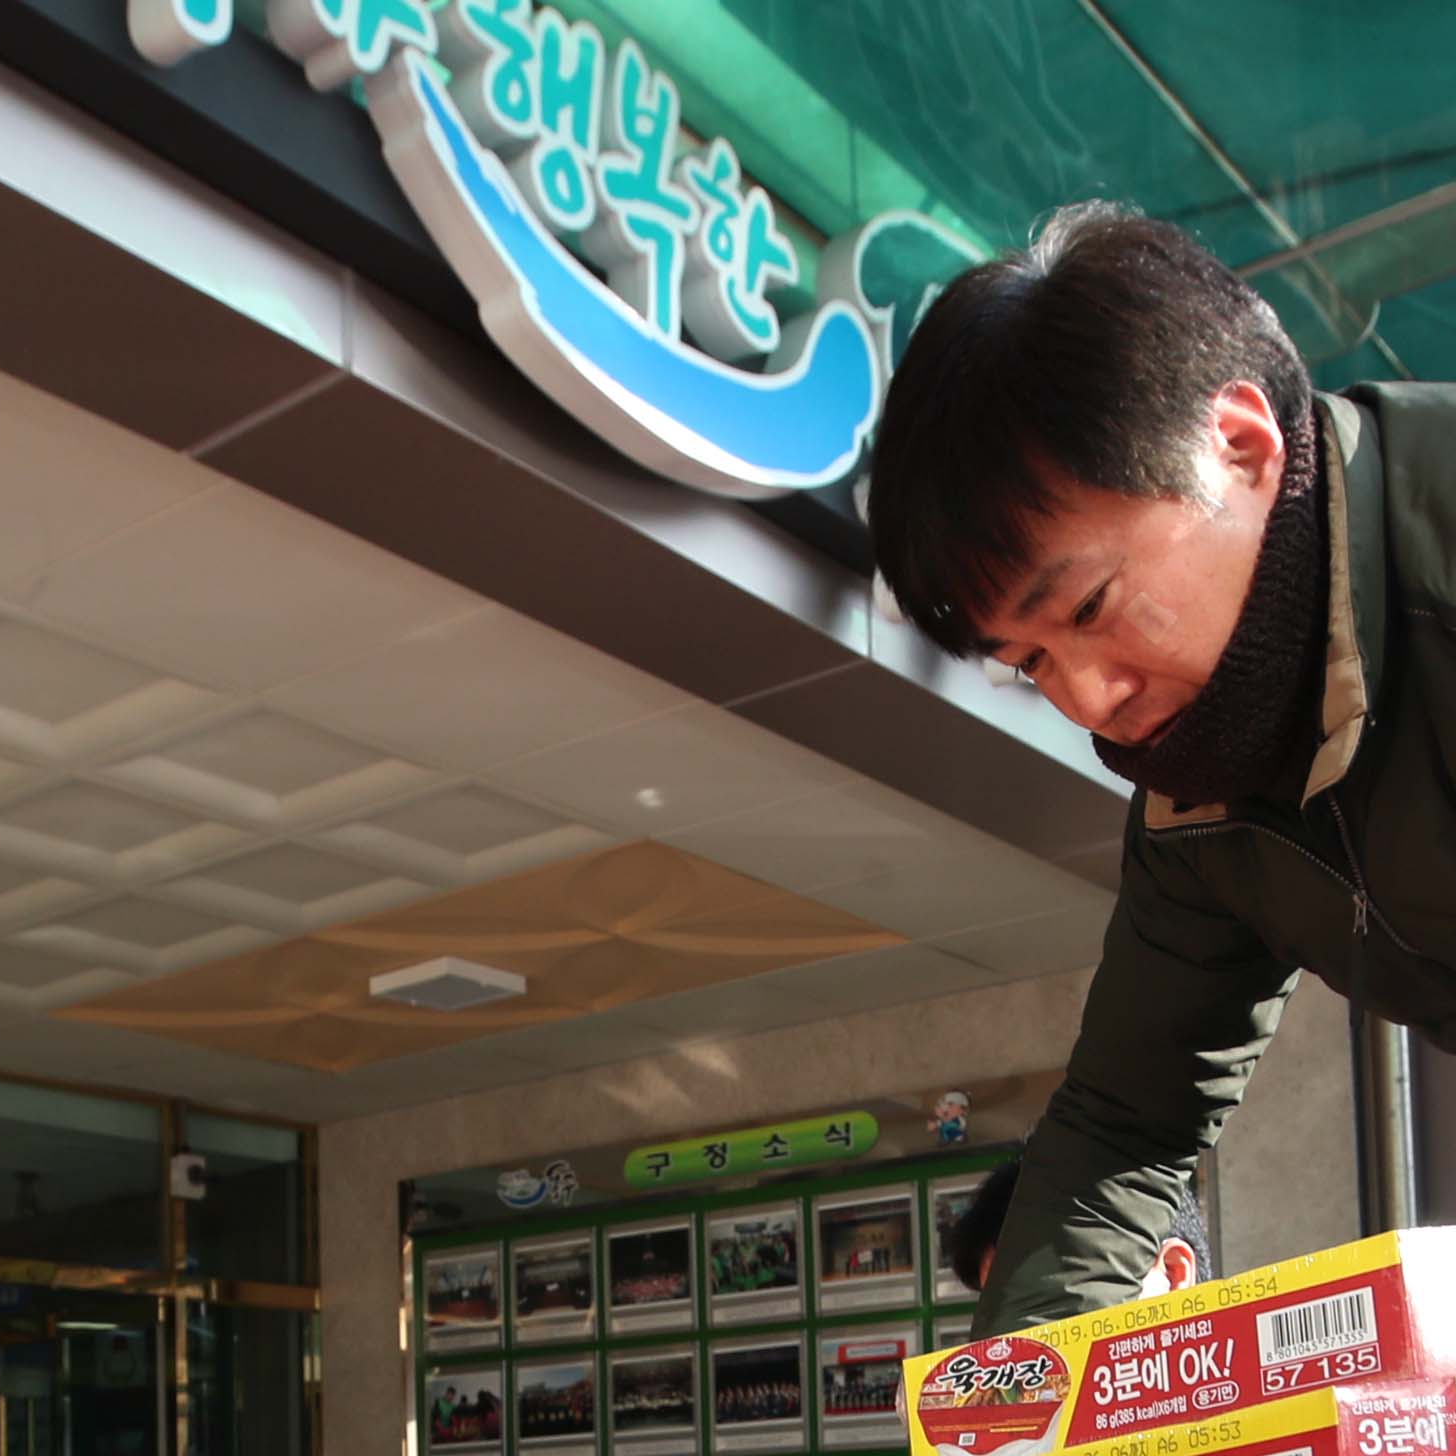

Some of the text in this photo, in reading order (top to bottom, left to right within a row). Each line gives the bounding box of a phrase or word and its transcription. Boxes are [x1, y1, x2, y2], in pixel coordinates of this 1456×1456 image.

[1180, 1297, 1207, 1315] A6
[1217, 1277, 1279, 1307] 05:54
[1108, 1319, 1213, 1359] 간편하게 즐기세요!
[938, 1355, 1053, 1394] 육개장
[1093, 1339, 1236, 1406] 3분에 OK!
[1265, 1350, 1377, 1391] 57 135
[1196, 1385, 1235, 1406] 용기면
[1158, 1437, 1178, 1455] A6
[1188, 1420, 1242, 1448] 05:53
[1358, 1420, 1448, 1455] 3분에
